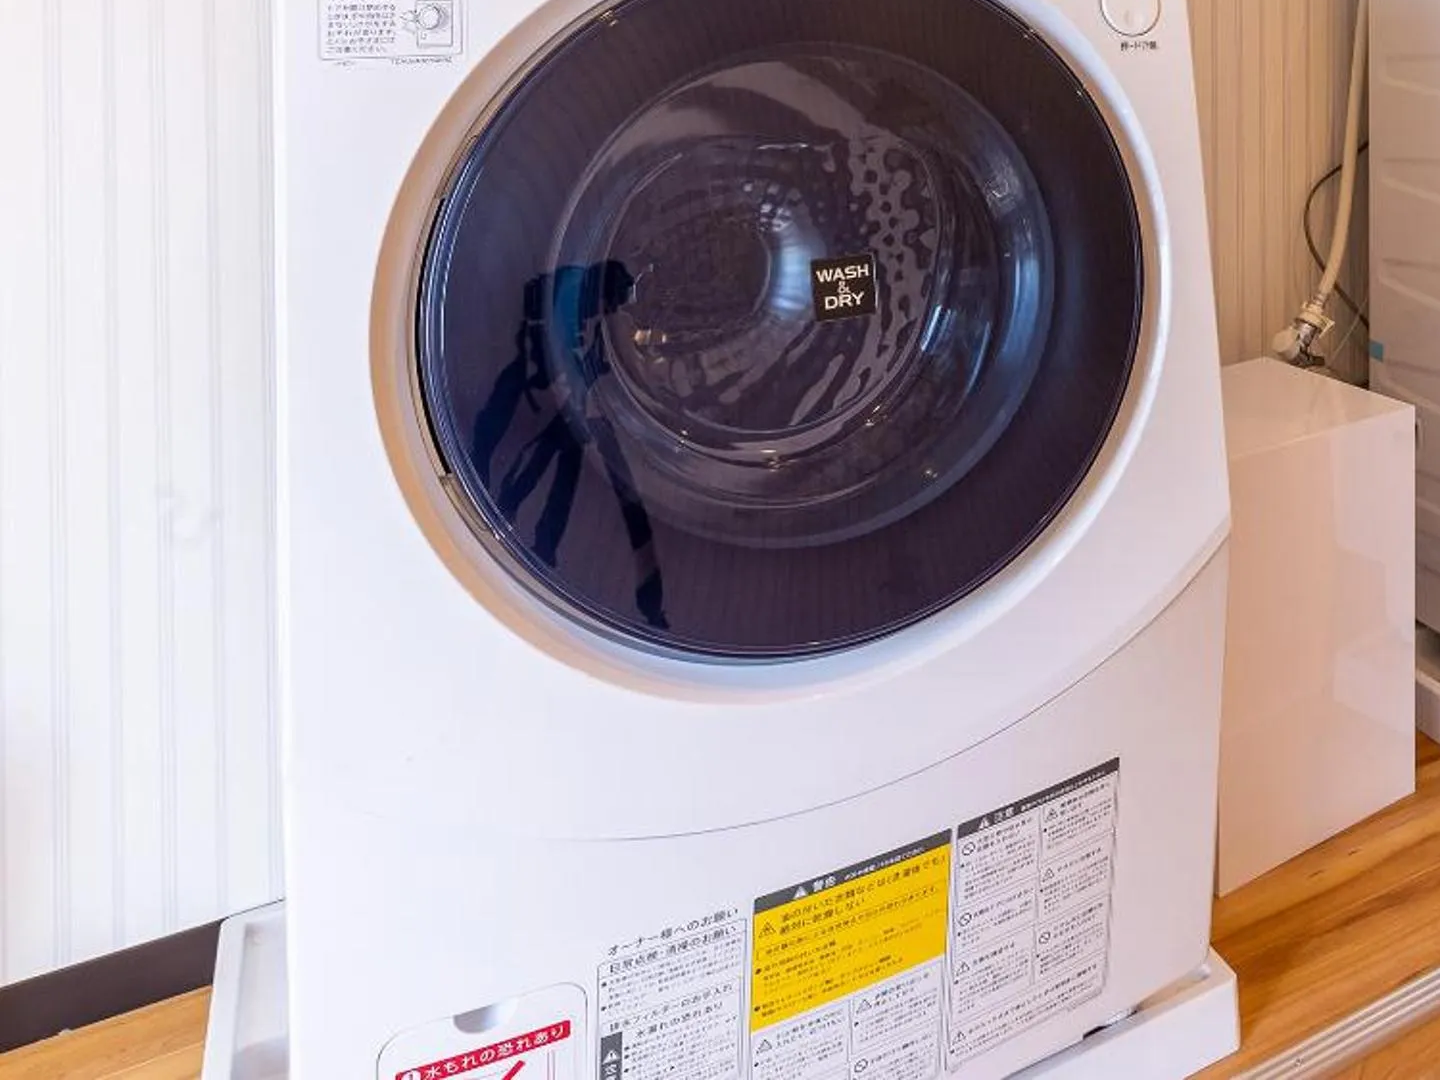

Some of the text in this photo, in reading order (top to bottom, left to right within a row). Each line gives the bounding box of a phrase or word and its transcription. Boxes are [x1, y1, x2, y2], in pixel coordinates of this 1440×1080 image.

[816, 263, 869, 282] WASH
[837, 280, 851, 294] &
[824, 291, 864, 310] DRY
[426, 1024, 564, 1079] 水もれの恐れあり
